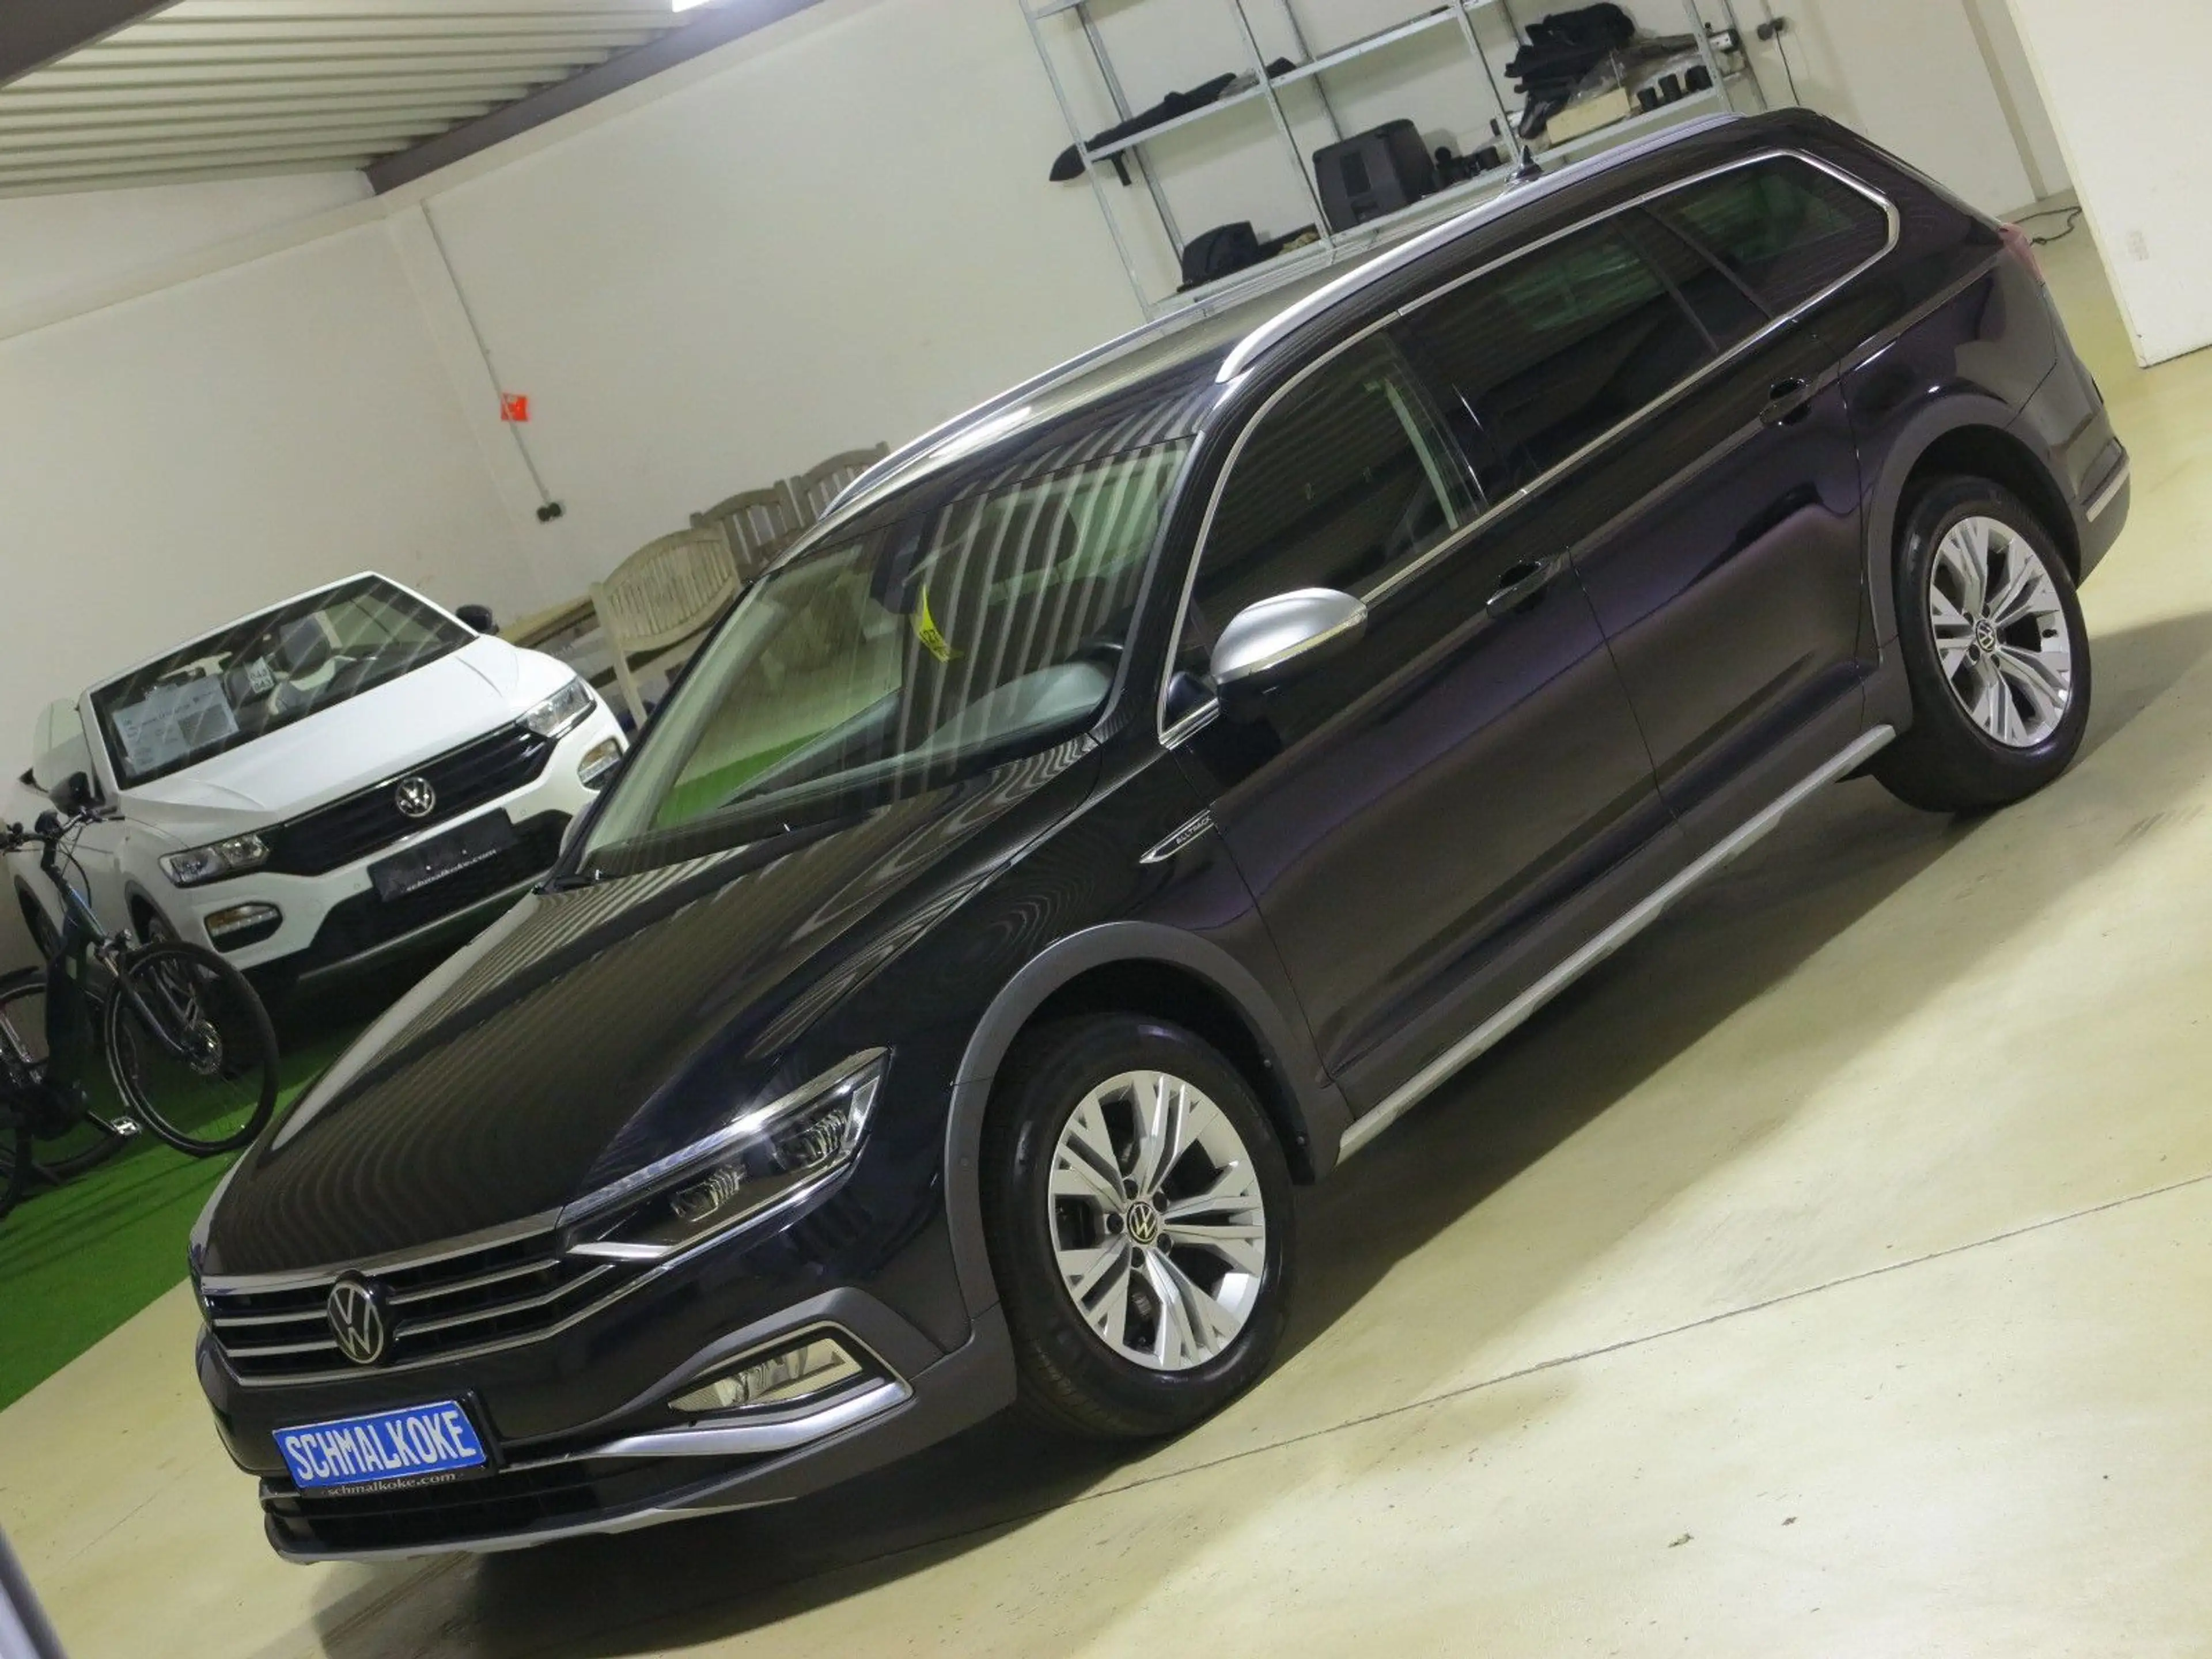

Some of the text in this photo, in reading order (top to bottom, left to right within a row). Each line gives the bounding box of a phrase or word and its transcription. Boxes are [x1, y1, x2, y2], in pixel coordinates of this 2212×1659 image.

[1129, 1203, 1157, 1243] VW
[327, 1279, 384, 1364] VW
[285, 1410, 477, 1481] SCHMALKOKE
[327, 1472, 456, 1496] schmalkoke.com
